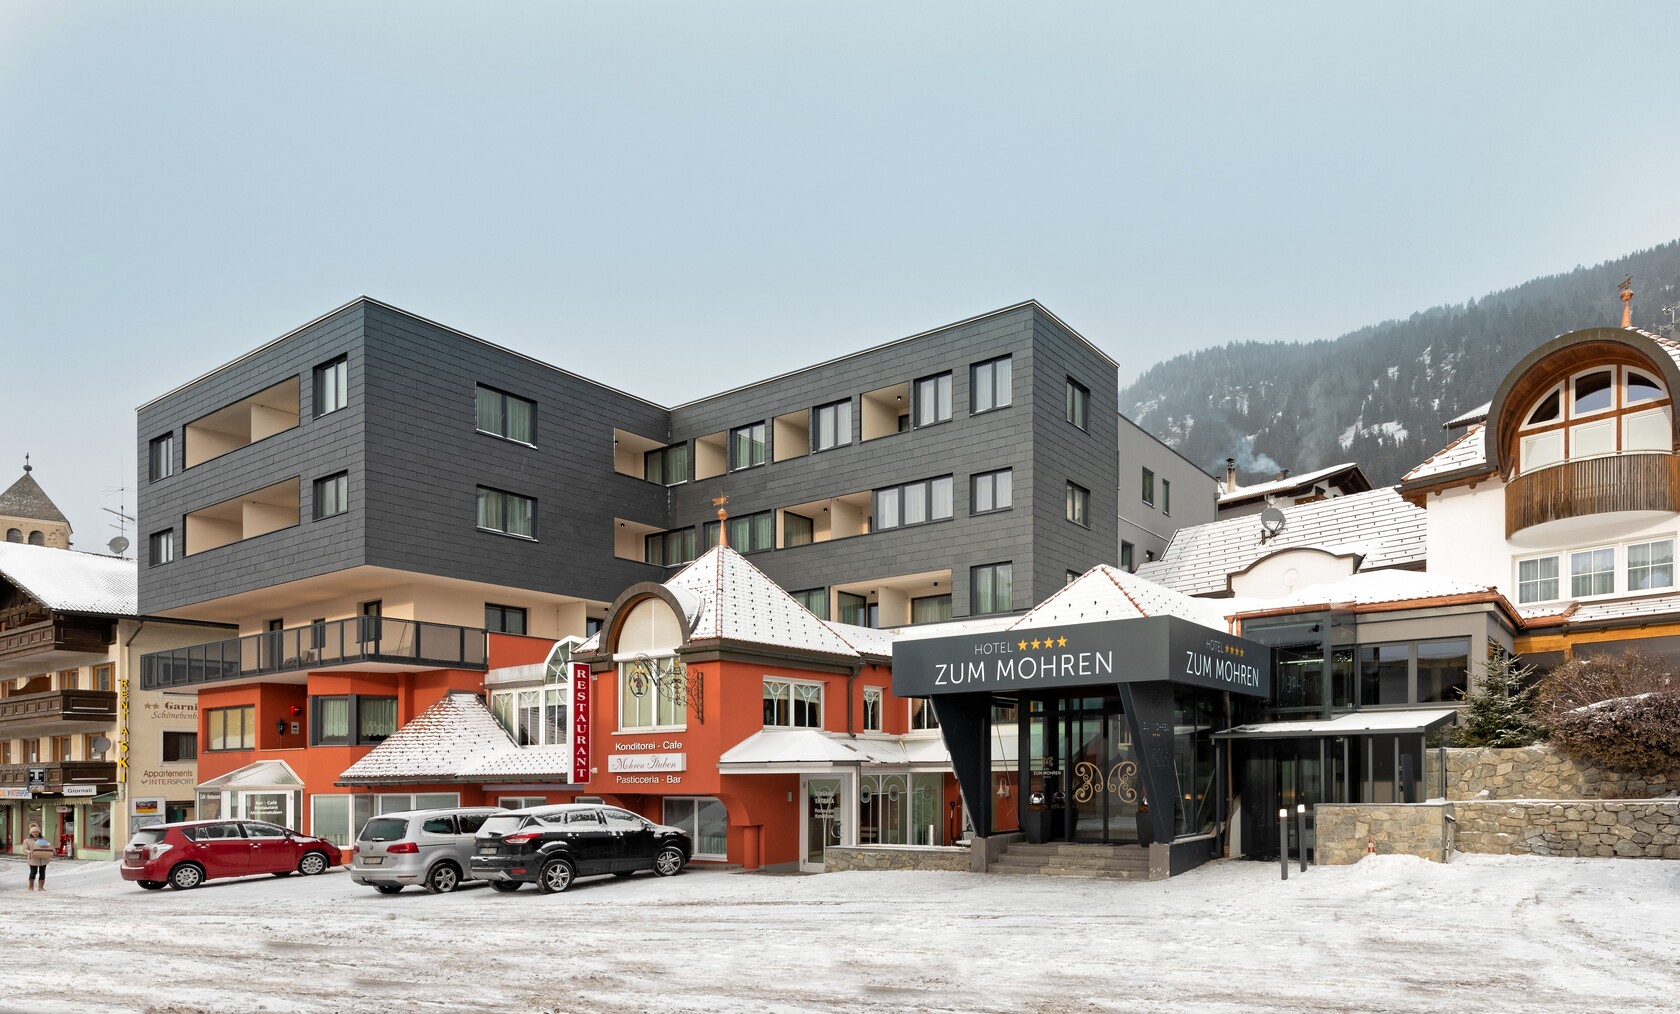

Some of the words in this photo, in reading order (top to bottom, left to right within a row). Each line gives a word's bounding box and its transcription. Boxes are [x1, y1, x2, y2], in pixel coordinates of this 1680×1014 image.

[974, 641, 1013, 655] HOTEL
[1206, 639, 1224, 654] HOTEL
[934, 661, 985, 685] ZUM
[996, 650, 1113, 681] MOHREN
[1186, 651, 1212, 678] ZUM
[1216, 658, 1259, 688] MOHREN
[121, 679, 130, 720] RENT
[164, 702, 198, 711] Garni
[151, 711, 198, 719] Schönebenb
[576, 669, 587, 778] RESTAURANT
[615, 742, 656, 751] Konditorei
[662, 741, 683, 750] Cafe
[118, 741, 130, 783] SKI
[612, 757, 645, 771] Mohren
[647, 755, 677, 769] Stuben
[143, 770, 193, 778] Appartements
[616, 775, 659, 784] Pasticceria
[666, 775, 682, 784] Bar
